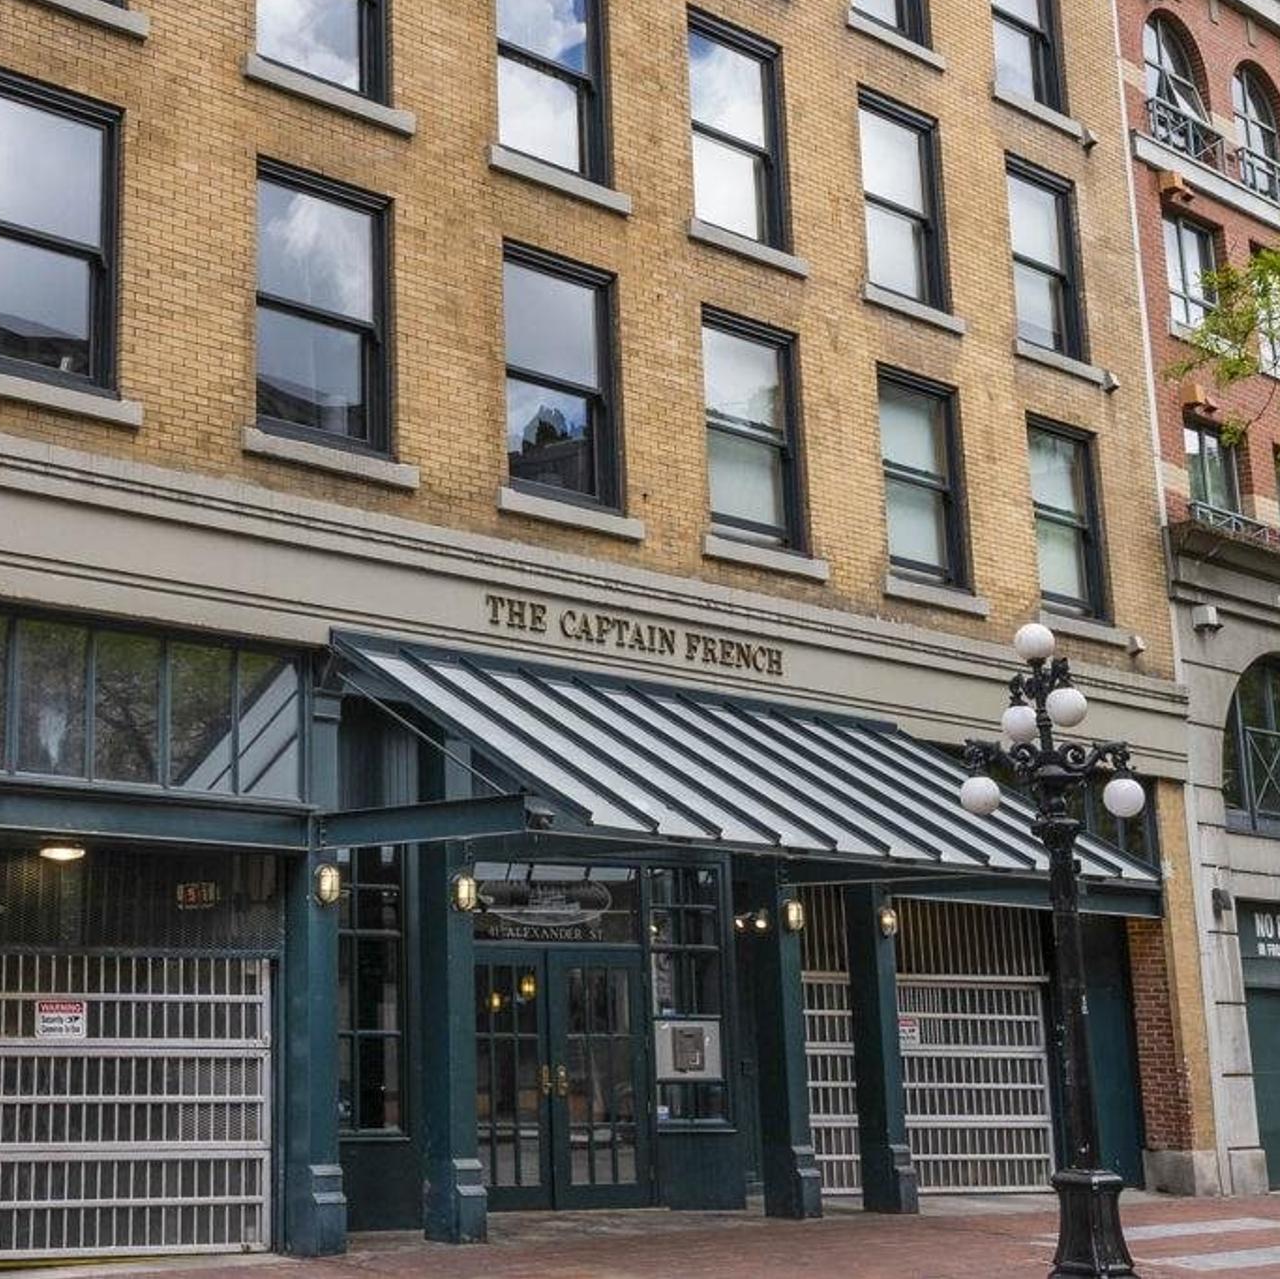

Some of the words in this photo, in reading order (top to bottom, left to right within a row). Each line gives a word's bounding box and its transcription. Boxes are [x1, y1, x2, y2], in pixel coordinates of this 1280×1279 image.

[486, 594, 547, 633] THE
[560, 608, 676, 657] CAPTAIN
[685, 632, 783, 676] FRENCH
[505, 926, 582, 940] ALEXANDER
[1254, 913, 1274, 938] NO
